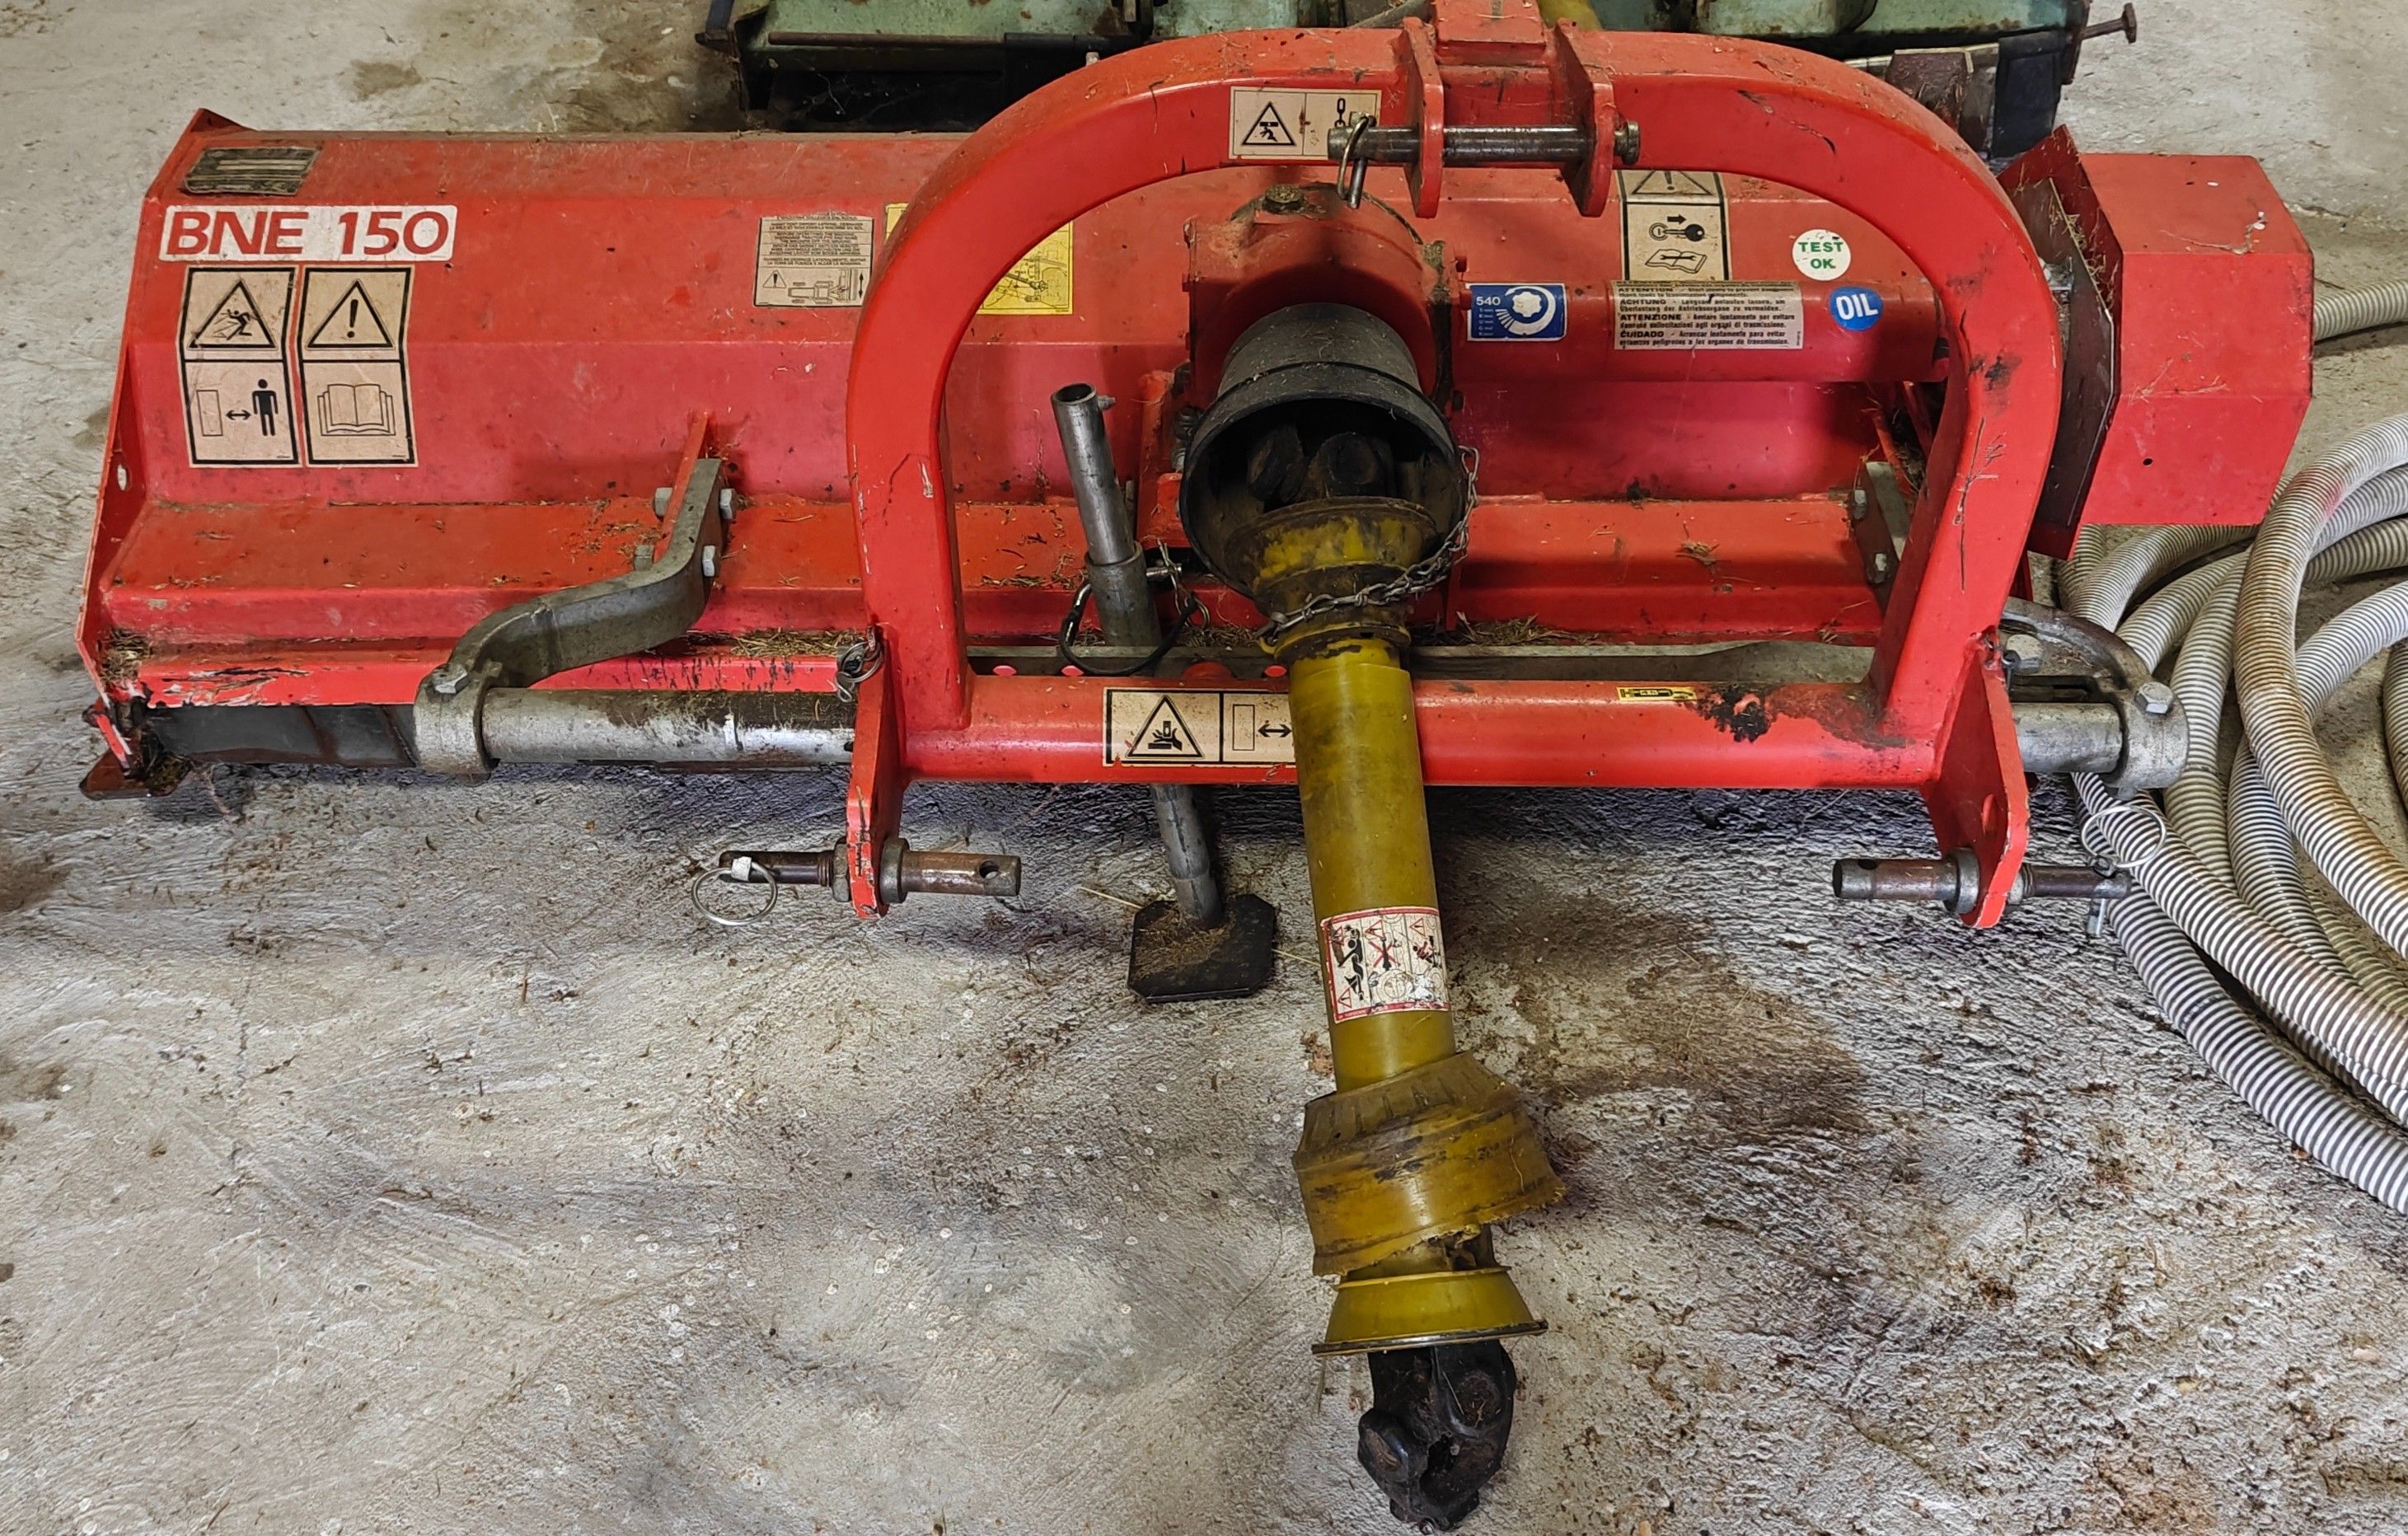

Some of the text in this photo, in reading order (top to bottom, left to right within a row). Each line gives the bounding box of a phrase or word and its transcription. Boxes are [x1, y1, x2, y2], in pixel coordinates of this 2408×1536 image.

[166, 210, 450, 255] BNE 150
[1798, 241, 1843, 269] TEST OK
[1476, 296, 1501, 306] 540
[1836, 293, 1878, 320] OIL
